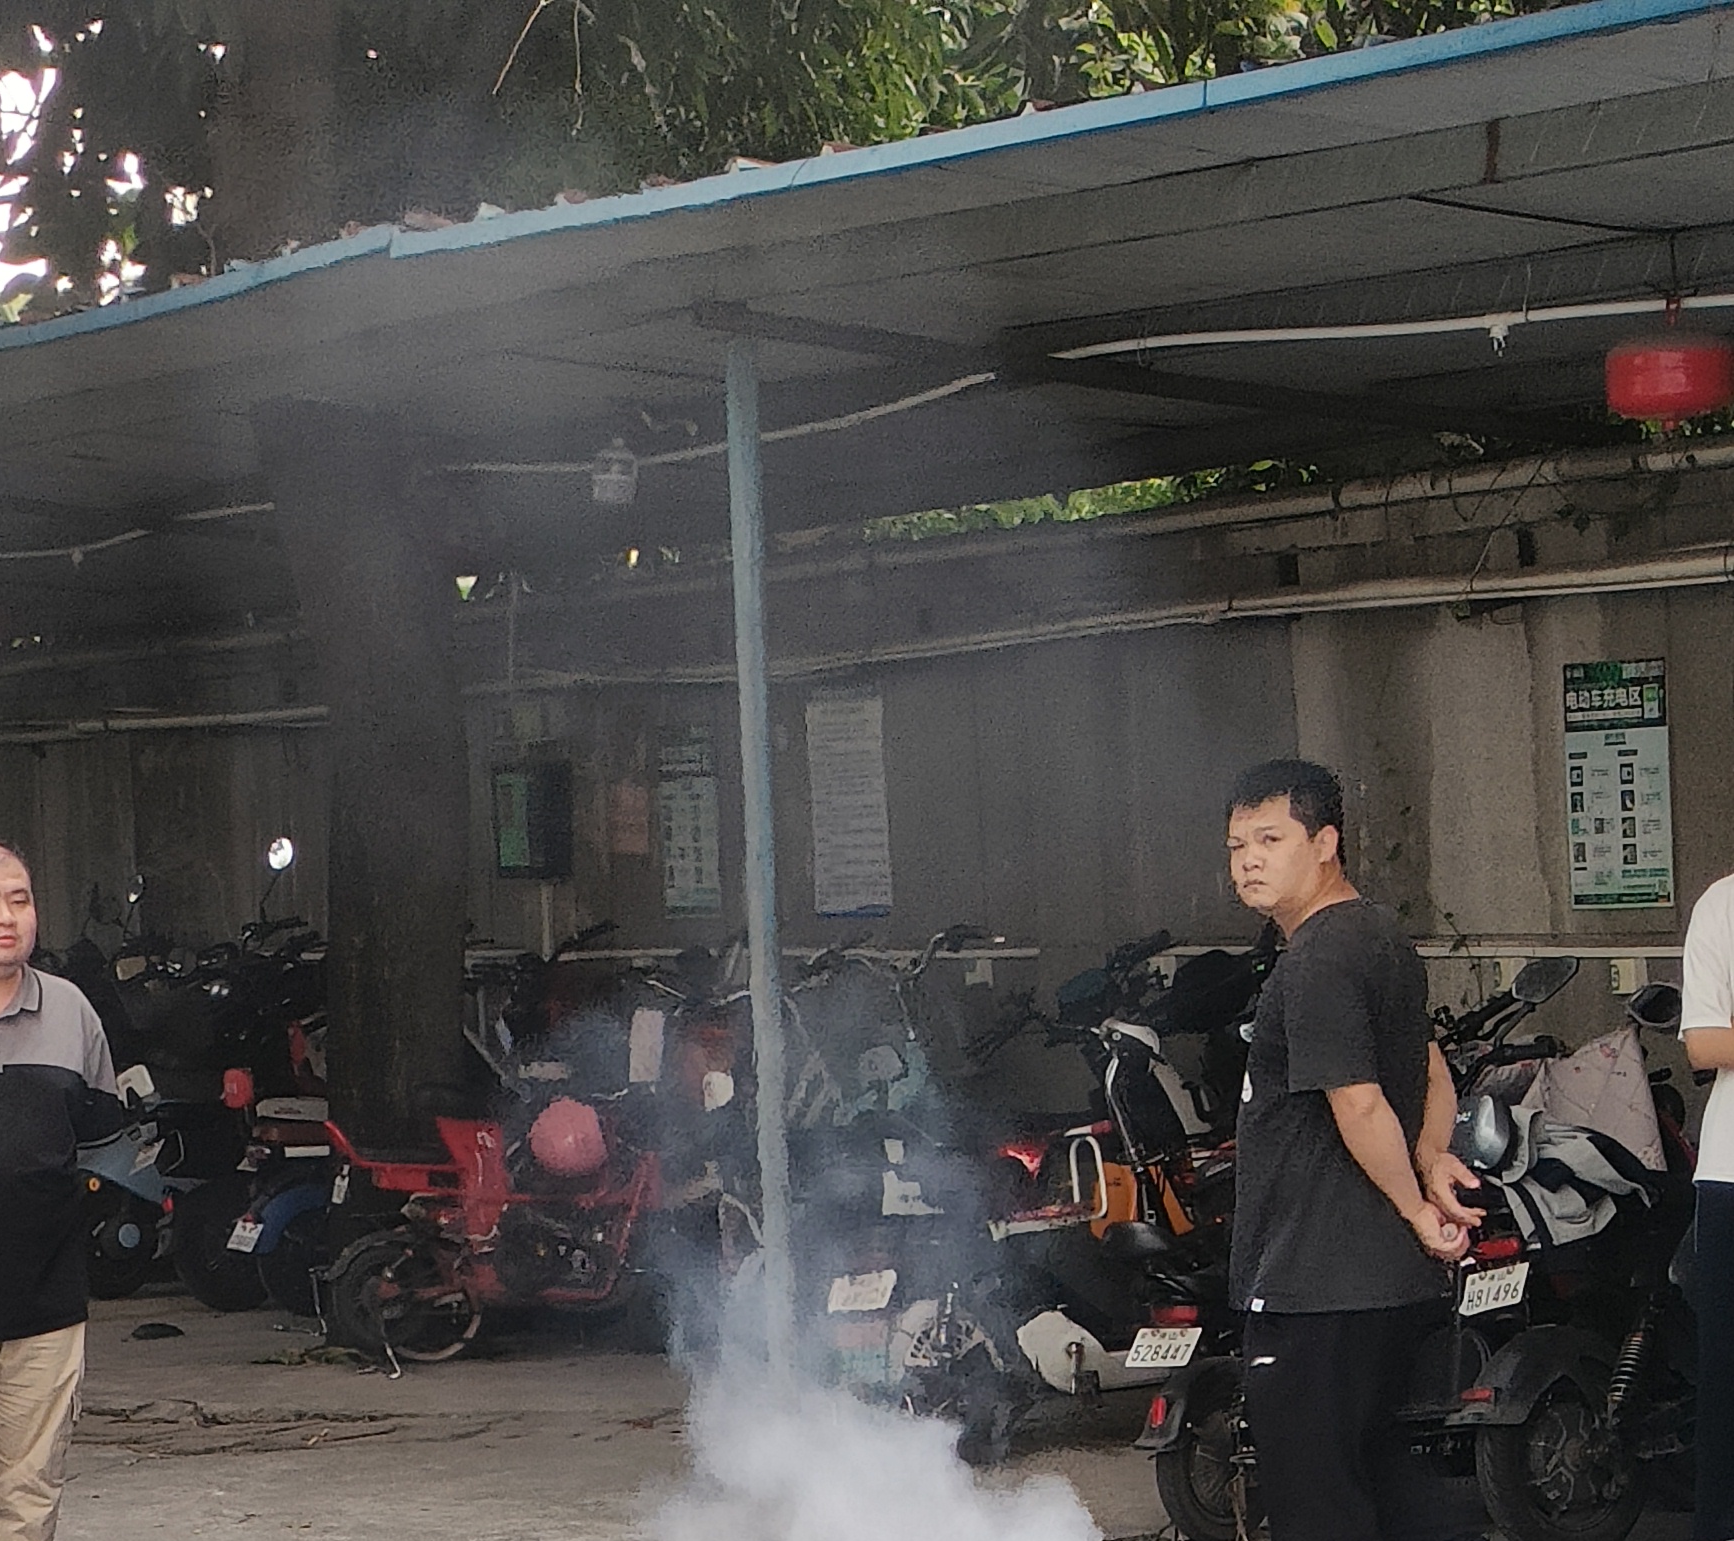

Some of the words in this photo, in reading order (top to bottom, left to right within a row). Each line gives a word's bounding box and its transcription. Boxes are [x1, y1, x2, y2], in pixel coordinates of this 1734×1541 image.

[1565, 686, 1642, 710] 电动车充电区
[1466, 1280, 1520, 1311] H81496
[1131, 1343, 1191, 1362] 528447
